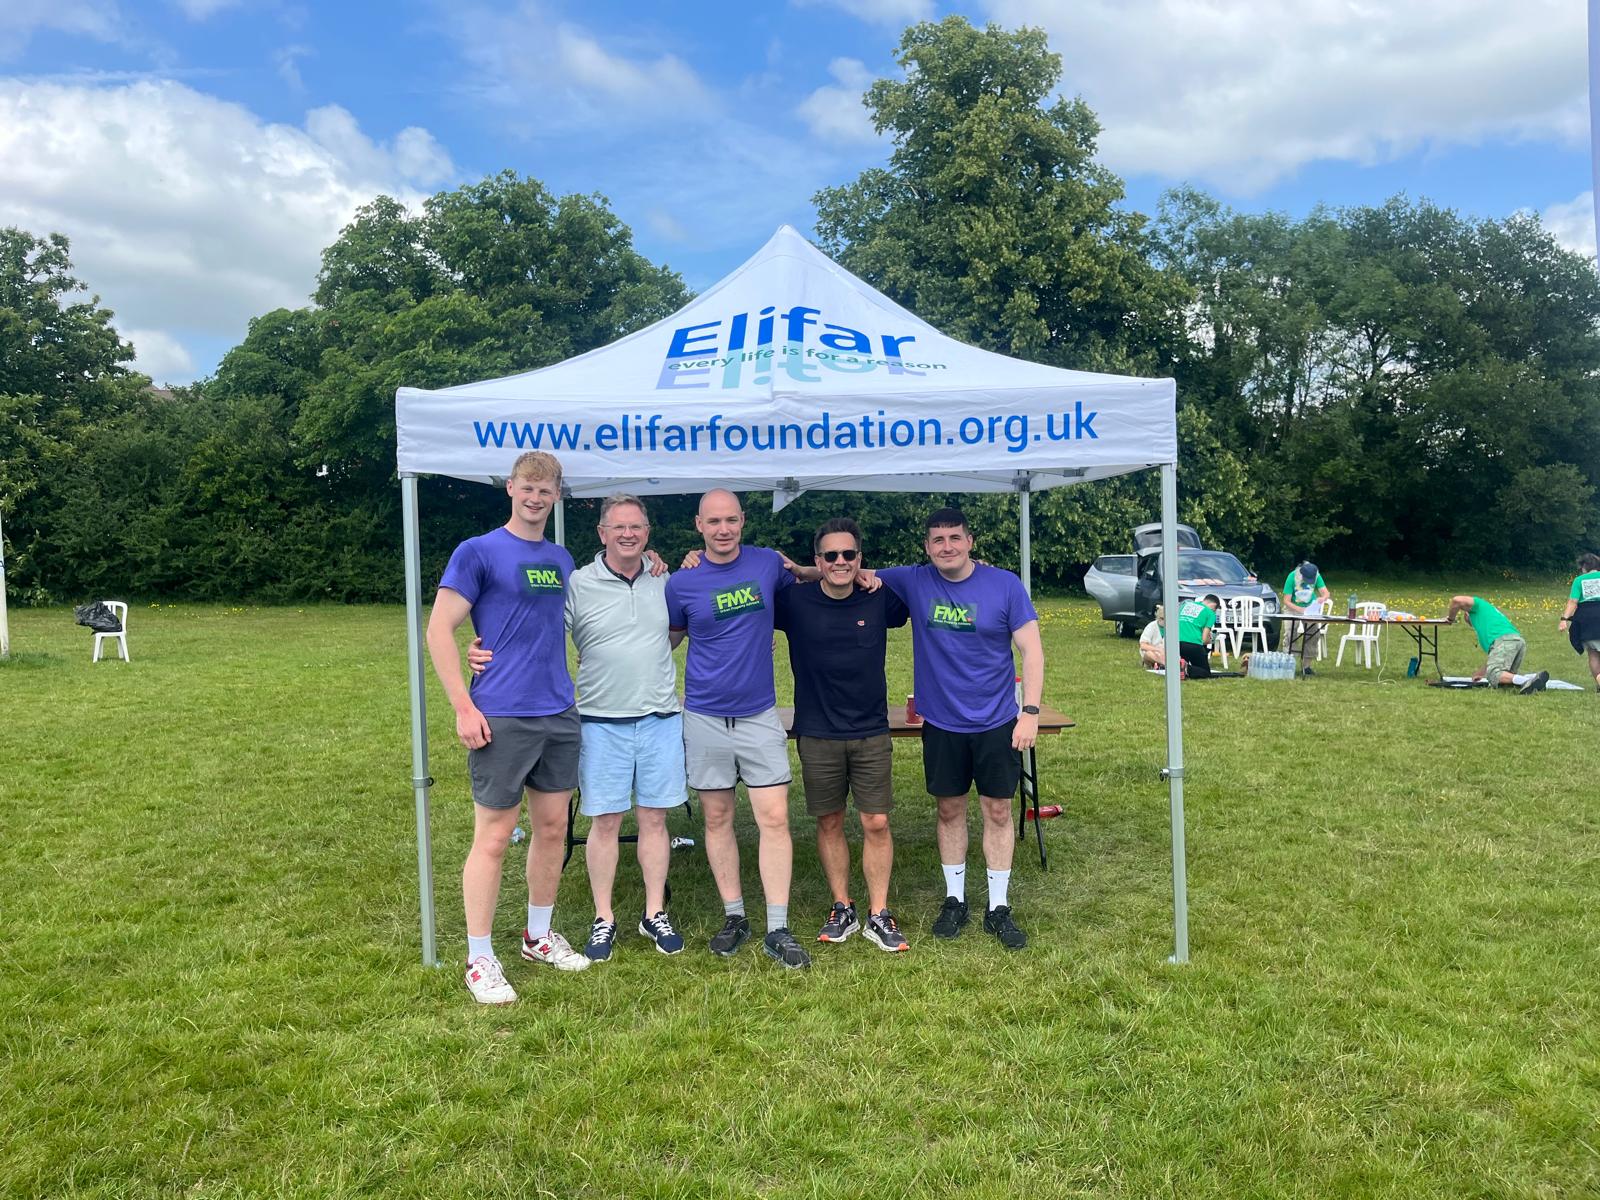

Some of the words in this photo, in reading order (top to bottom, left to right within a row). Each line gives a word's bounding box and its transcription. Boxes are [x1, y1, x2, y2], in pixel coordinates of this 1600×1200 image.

[666, 306, 916, 359] Elifar
[668, 357, 734, 371] every
[740, 348, 775, 363] life
[782, 345, 800, 356] is
[805, 348, 839, 361] for
[846, 354, 860, 364] a
[866, 358, 948, 370] reason
[473, 401, 1099, 453] www.elifarfoundation.org.uk
